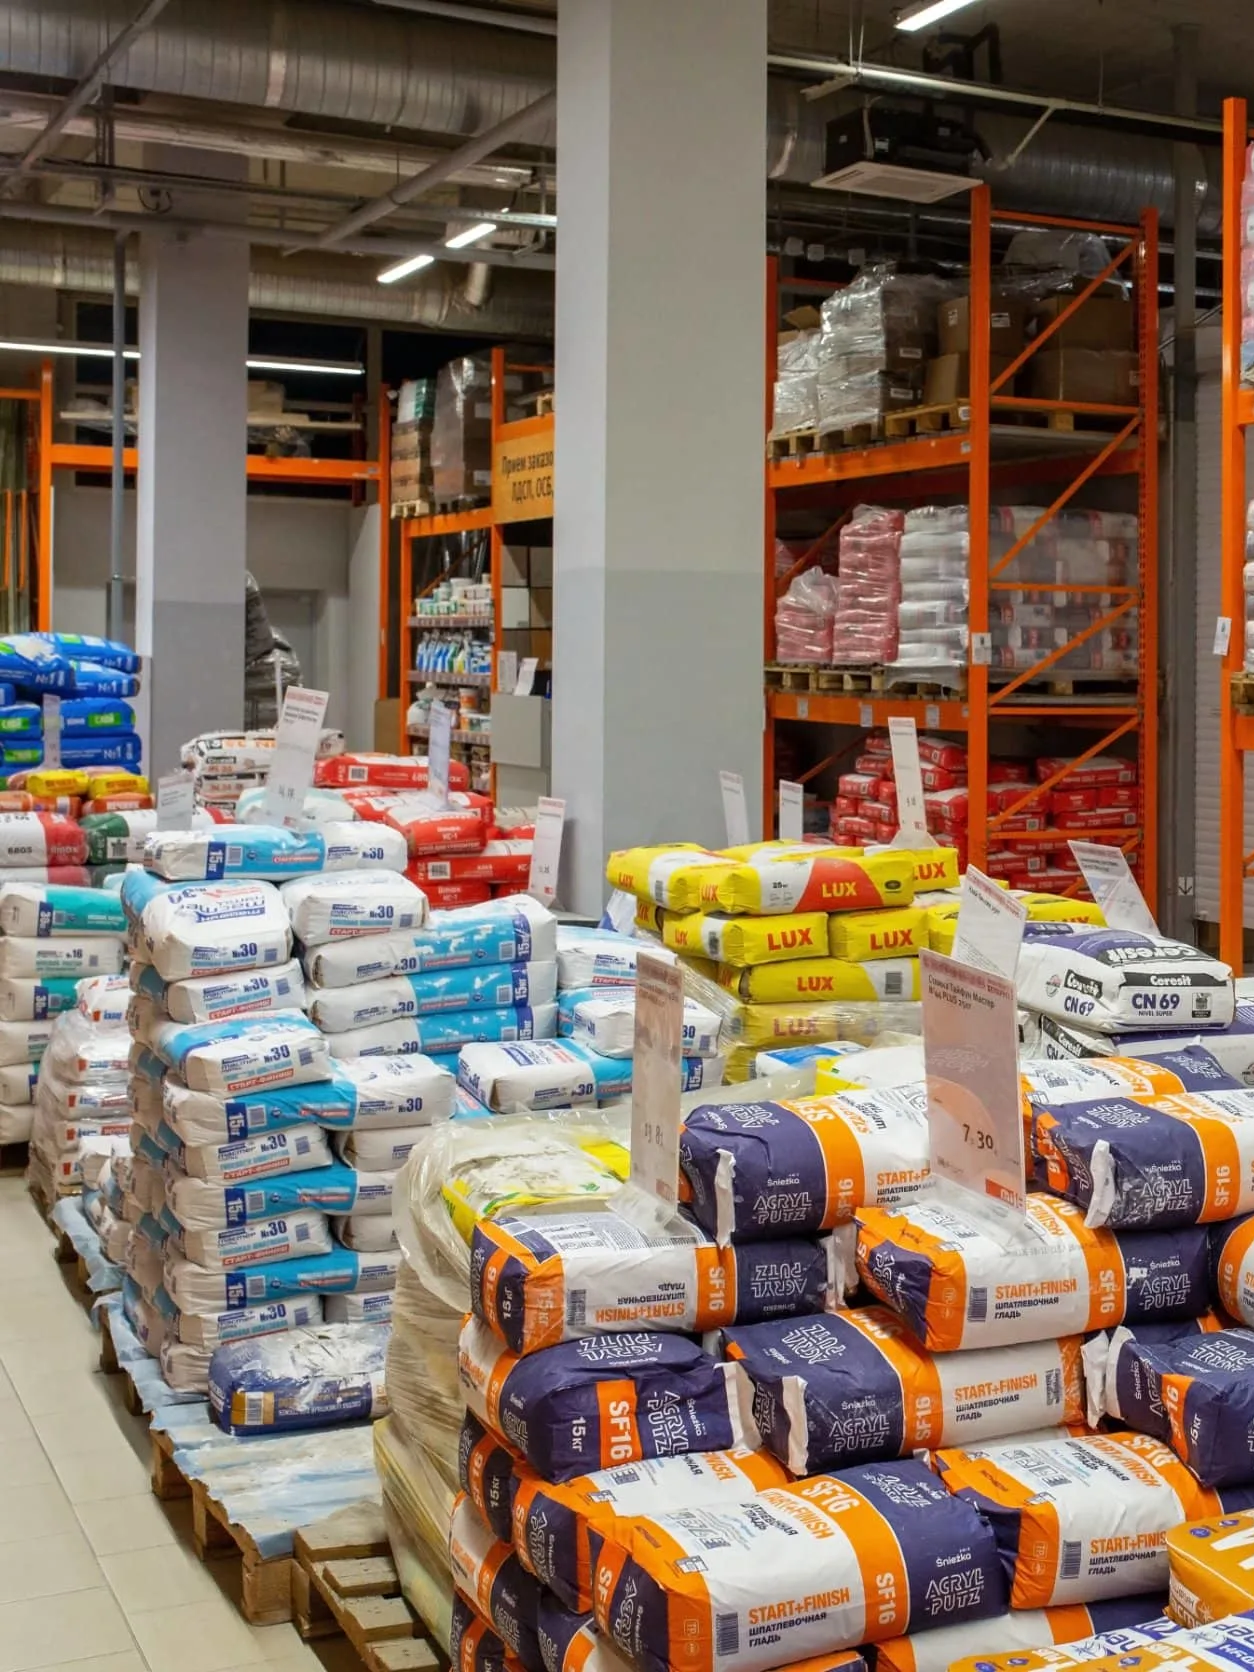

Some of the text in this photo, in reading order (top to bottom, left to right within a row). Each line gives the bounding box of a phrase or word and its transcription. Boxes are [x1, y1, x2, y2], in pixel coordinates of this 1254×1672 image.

[618, 872, 635, 890] LUX
[822, 881, 857, 898] LUX
[767, 927, 813, 952] LUX
[870, 928, 914, 951] LUX
[797, 976, 834, 992] LUX
[1149, 974, 1192, 987] Ceresit
[1064, 995, 1095, 1017] CN 69
[1131, 993, 1181, 1010] CN 69
[773, 1018, 818, 1037] LUX
[767, 1176, 800, 1187] Śnieżka
[1140, 1178, 1193, 1198] ACRYL
[1213, 1164, 1231, 1208] SF16
[752, 1192, 813, 1211] ACRYL
[836, 1178, 855, 1218] SF16
[708, 1267, 725, 1312] SF16
[750, 1280, 807, 1298] ACRYL
[994, 1278, 1078, 1299] START+FINISH
[1100, 1269, 1115, 1314] SF16
[1140, 1273, 1192, 1293] ACRYL
[994, 1296, 1059, 1311] ШПАТЛЕВОЧНАЯ
[994, 1309, 1022, 1321] ГЛАДЬ
[954, 1373, 1039, 1402] START+FINISH
[663, 1390, 690, 1458] ACRYL
[829, 1415, 891, 1438] ACRYL
[914, 1395, 932, 1441] SF16
[608, 1400, 633, 1460] SF16
[801, 1477, 860, 1516] SF16
[1090, 1529, 1168, 1554] START+FINIS
[935, 1551, 972, 1568] Śnieżka
[1089, 1550, 1157, 1565] ШПАТЛЕВОЧНАЯ
[924, 1568, 985, 1600] ACRYL
[748, 1587, 851, 1624] START+FINISH
[875, 1573, 897, 1626] SF16
[749, 1611, 827, 1636] ШПАТЛЕВОЧНАЯ
[749, 1633, 782, 1648] ГЛАДЬ
